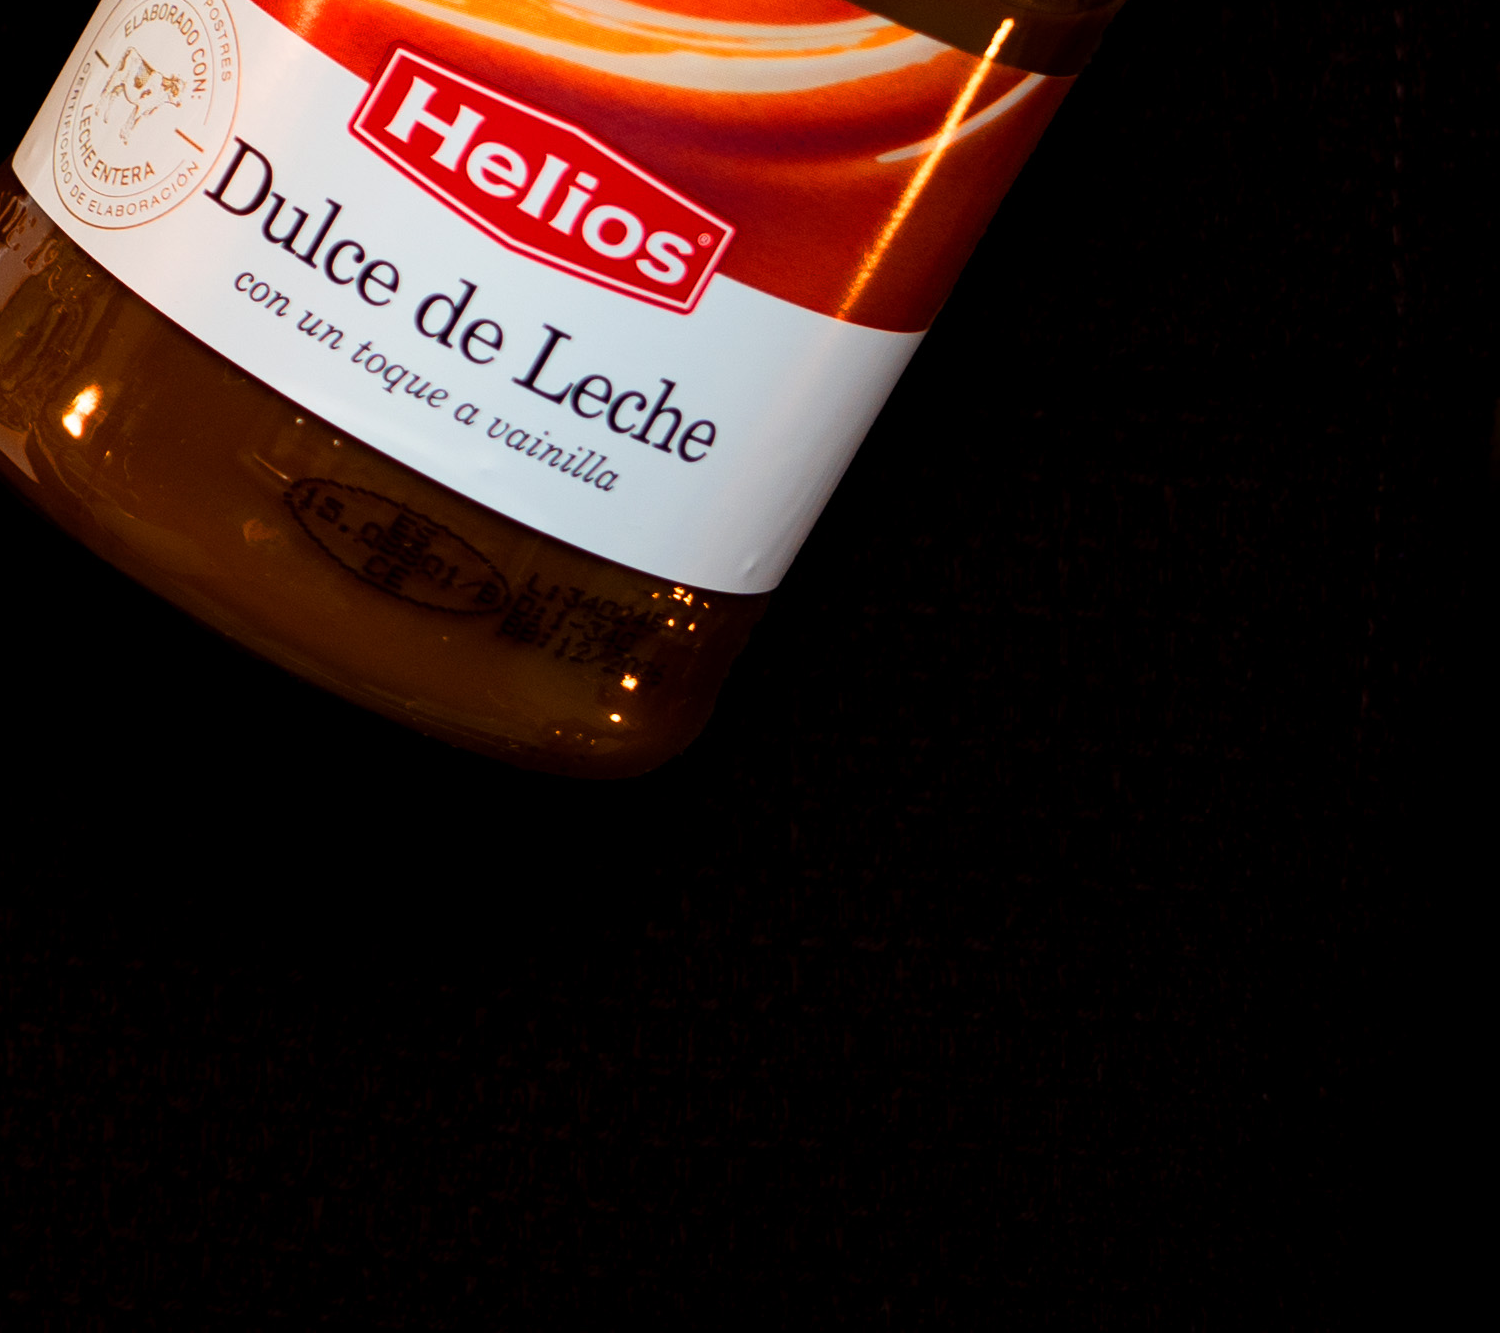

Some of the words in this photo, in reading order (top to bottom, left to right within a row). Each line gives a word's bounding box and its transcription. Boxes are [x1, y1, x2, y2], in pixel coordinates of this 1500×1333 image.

[124, 2, 201, 46] ELABORADO
[190, 46, 208, 100] CON:
[69, 184, 84, 206] DE
[87, 160, 200, 218] ELABORACIÓN
[77, 103, 94, 168] LECHE
[91, 160, 156, 186] ENTERA
[382, 75, 696, 286] Helios
[202, 134, 401, 308] Dulce
[412, 276, 505, 366] de
[510, 322, 719, 464] Leche
[233, 269, 292, 318] con
[295, 308, 347, 352] un
[349, 340, 450, 410] toque
[452, 397, 482, 427] a
[485, 415, 622, 494] vainilla
